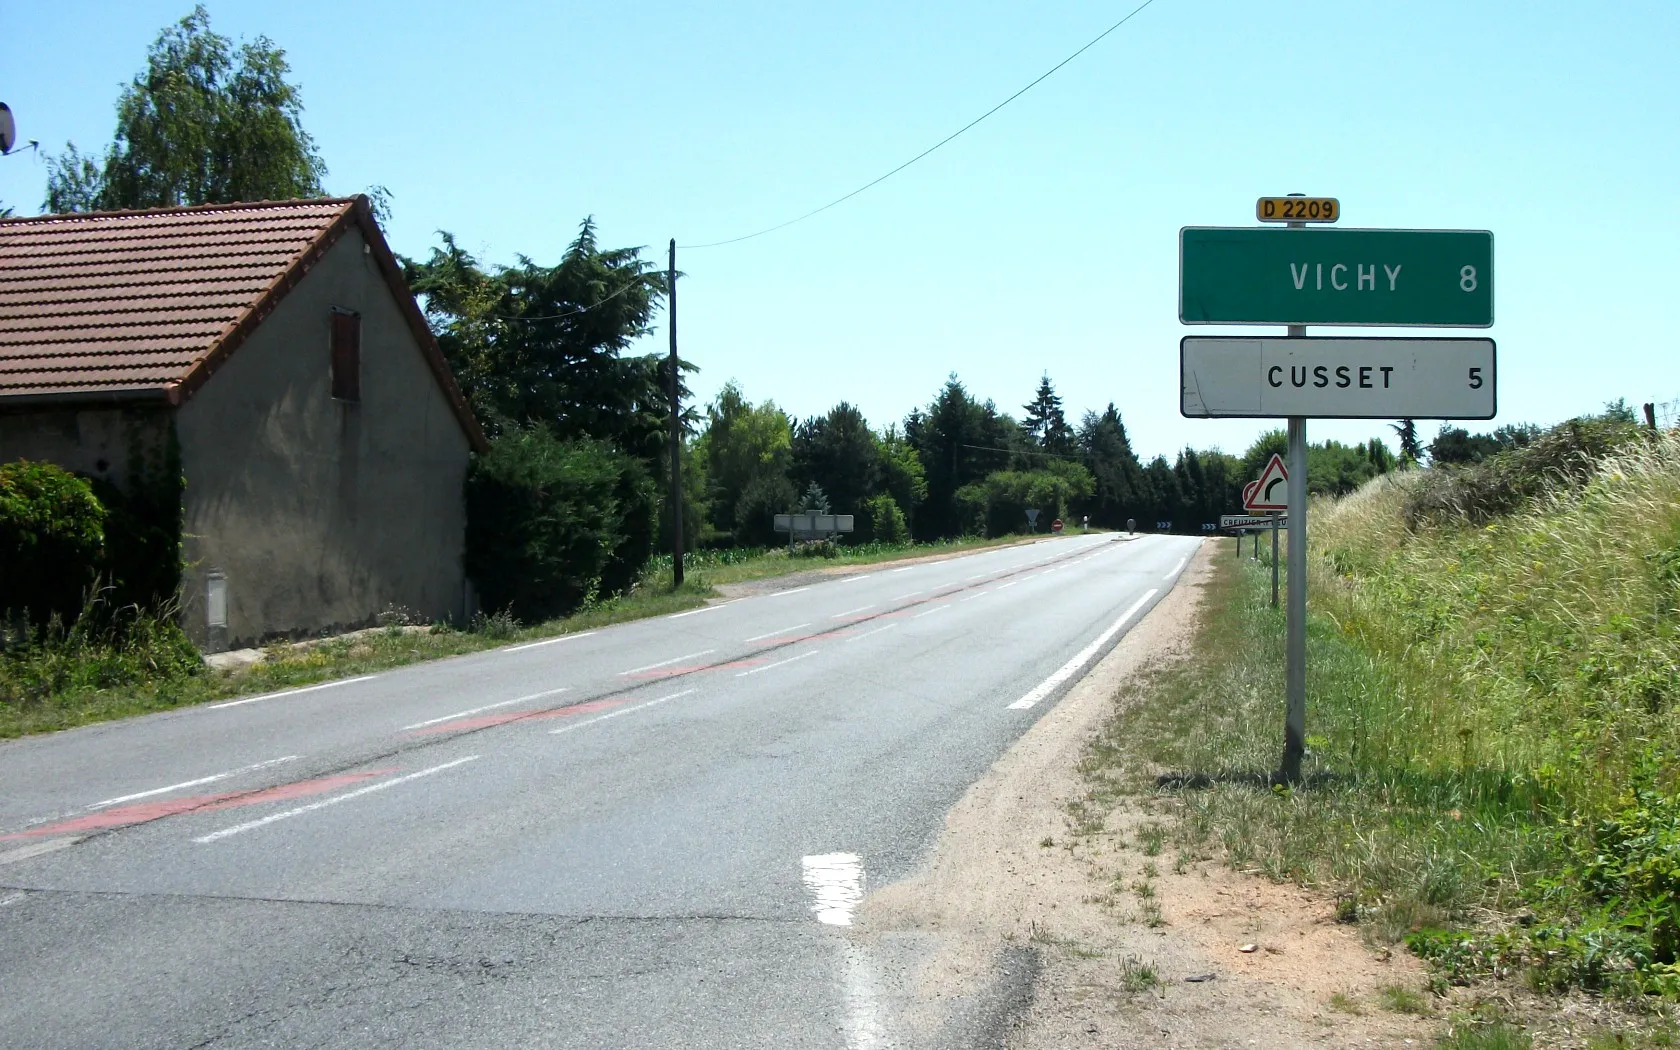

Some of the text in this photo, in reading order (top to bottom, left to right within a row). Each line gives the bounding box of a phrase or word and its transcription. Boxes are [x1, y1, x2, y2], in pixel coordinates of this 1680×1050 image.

[1264, 200, 1333, 218] D 2209
[1290, 263, 1477, 292] VICHY 8
[1268, 366, 1483, 389] CUSSET 5
